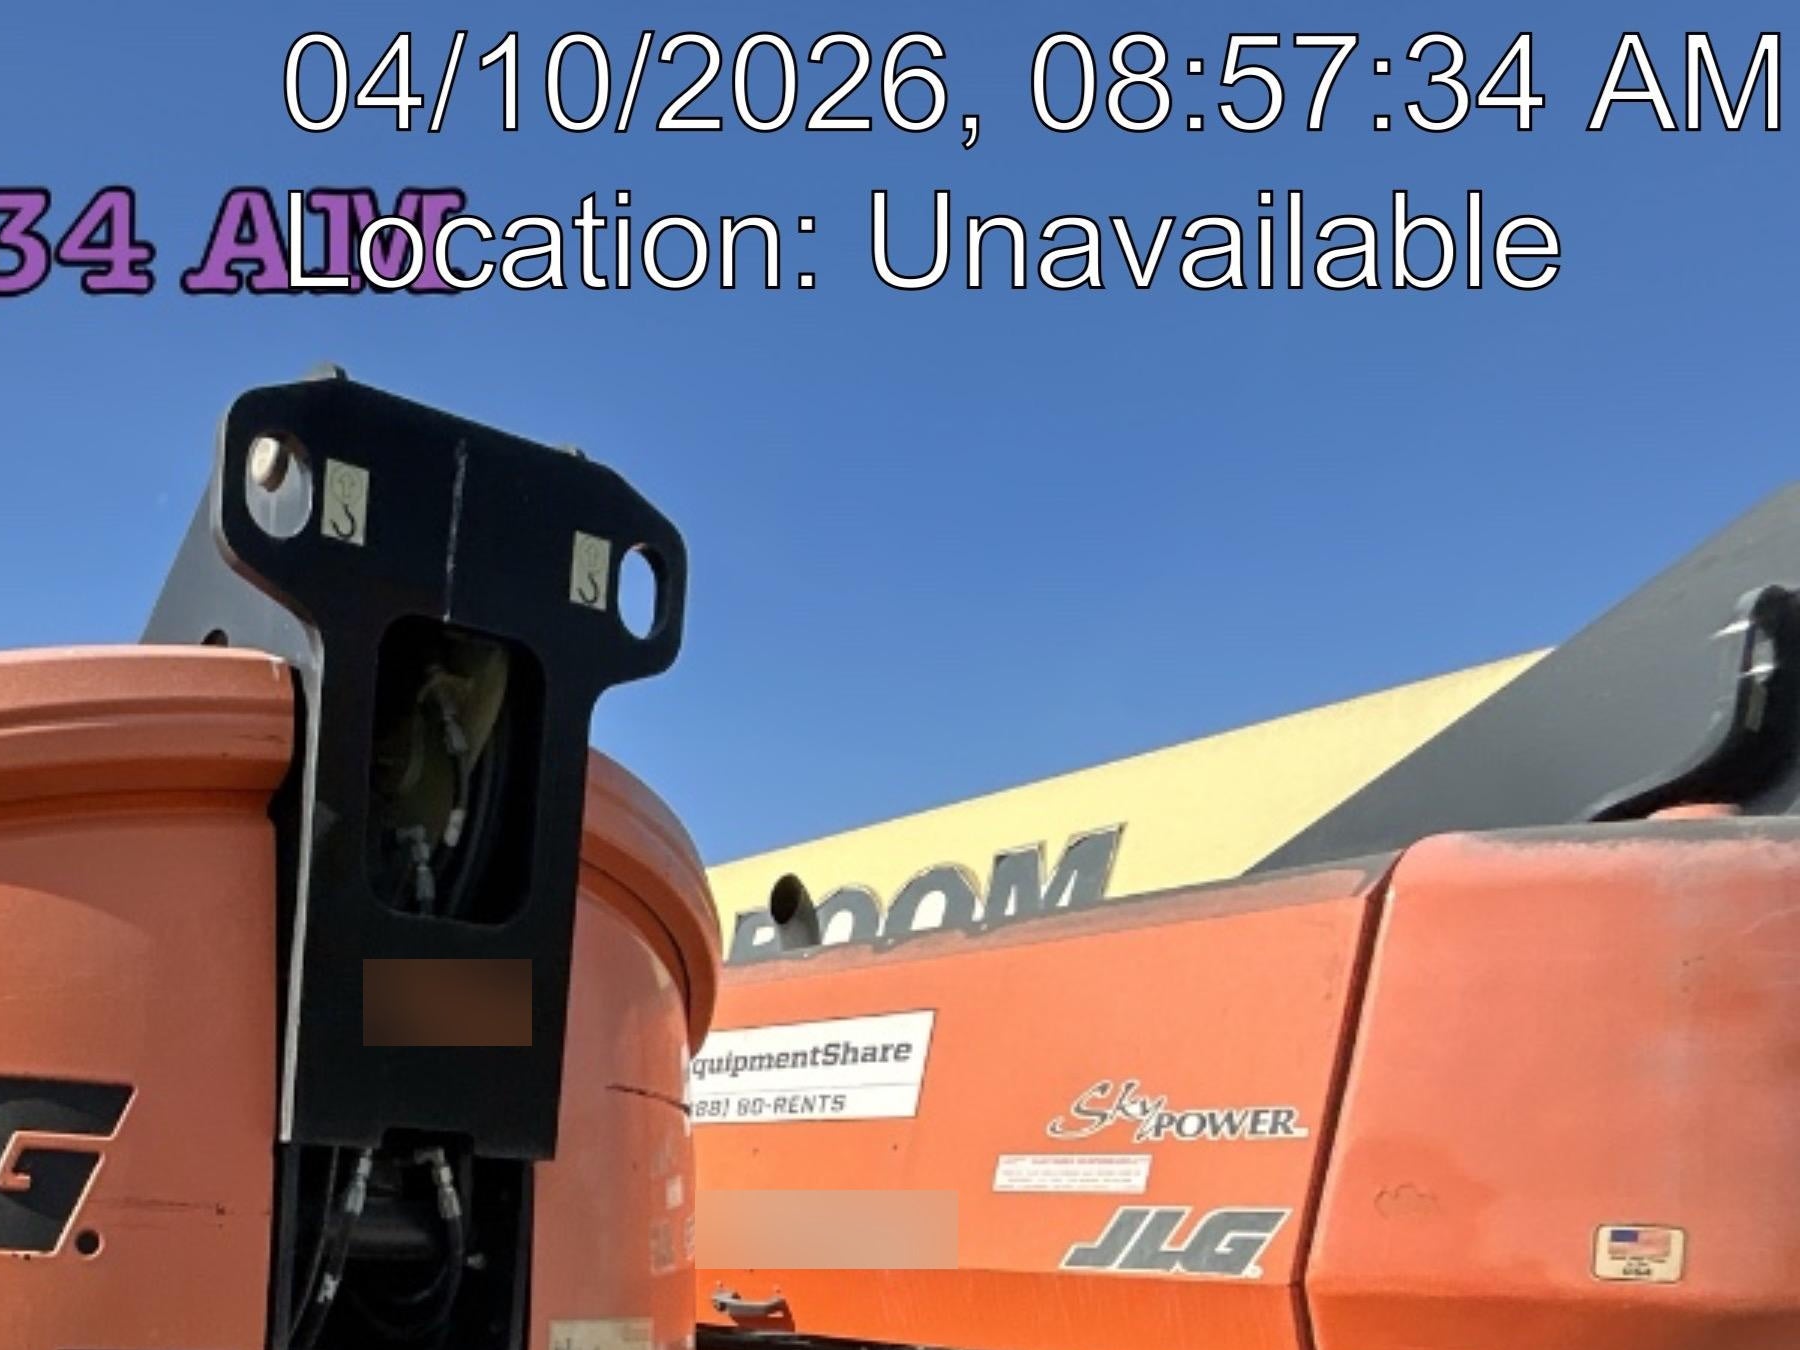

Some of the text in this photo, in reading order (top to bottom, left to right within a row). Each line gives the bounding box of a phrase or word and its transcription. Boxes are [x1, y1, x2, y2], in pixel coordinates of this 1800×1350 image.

[688, 1040, 913, 1080] quipmentShare
[690, 1097, 730, 1119] 88)
[1059, 1206, 1293, 1278] JLG
